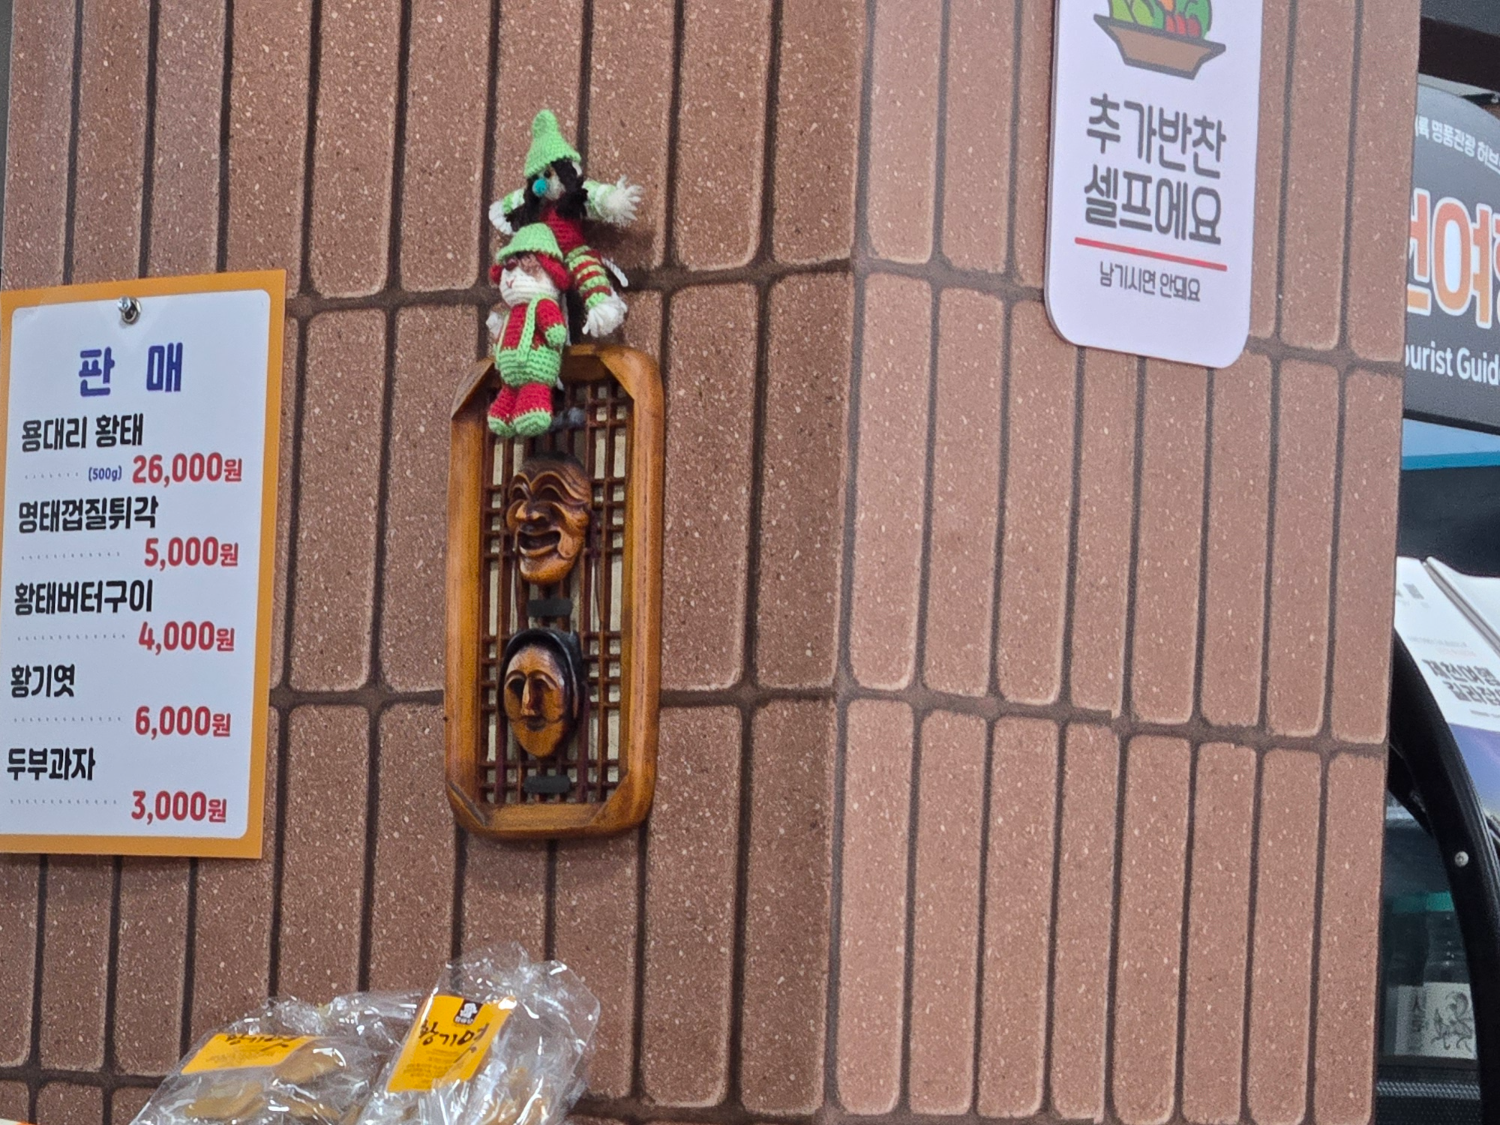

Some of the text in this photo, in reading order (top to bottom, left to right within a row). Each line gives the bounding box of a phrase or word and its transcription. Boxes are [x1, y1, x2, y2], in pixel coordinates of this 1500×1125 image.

[1086, 93, 1226, 179] 추가반찬
[1084, 163, 1222, 245] 셀프에요
[1100, 261, 1156, 296] 남기시면
[78, 342, 184, 397] 판 매
[1405, 341, 1500, 386] urist Guid
[21, 413, 145, 452] 용대리 황태
[88, 452, 243, 486] (500g) 26,000원
[18, 496, 159, 533] 명태껍질튀각
[143, 536, 240, 570] 5,000원
[14, 579, 154, 616] 황태버터구이
[138, 621, 235, 655] 4,000원
[10, 664, 76, 699] 황기엿
[135, 705, 231, 740] 6,000원
[7, 748, 96, 782] 두부과자
[131, 791, 228, 825] 3,000원
